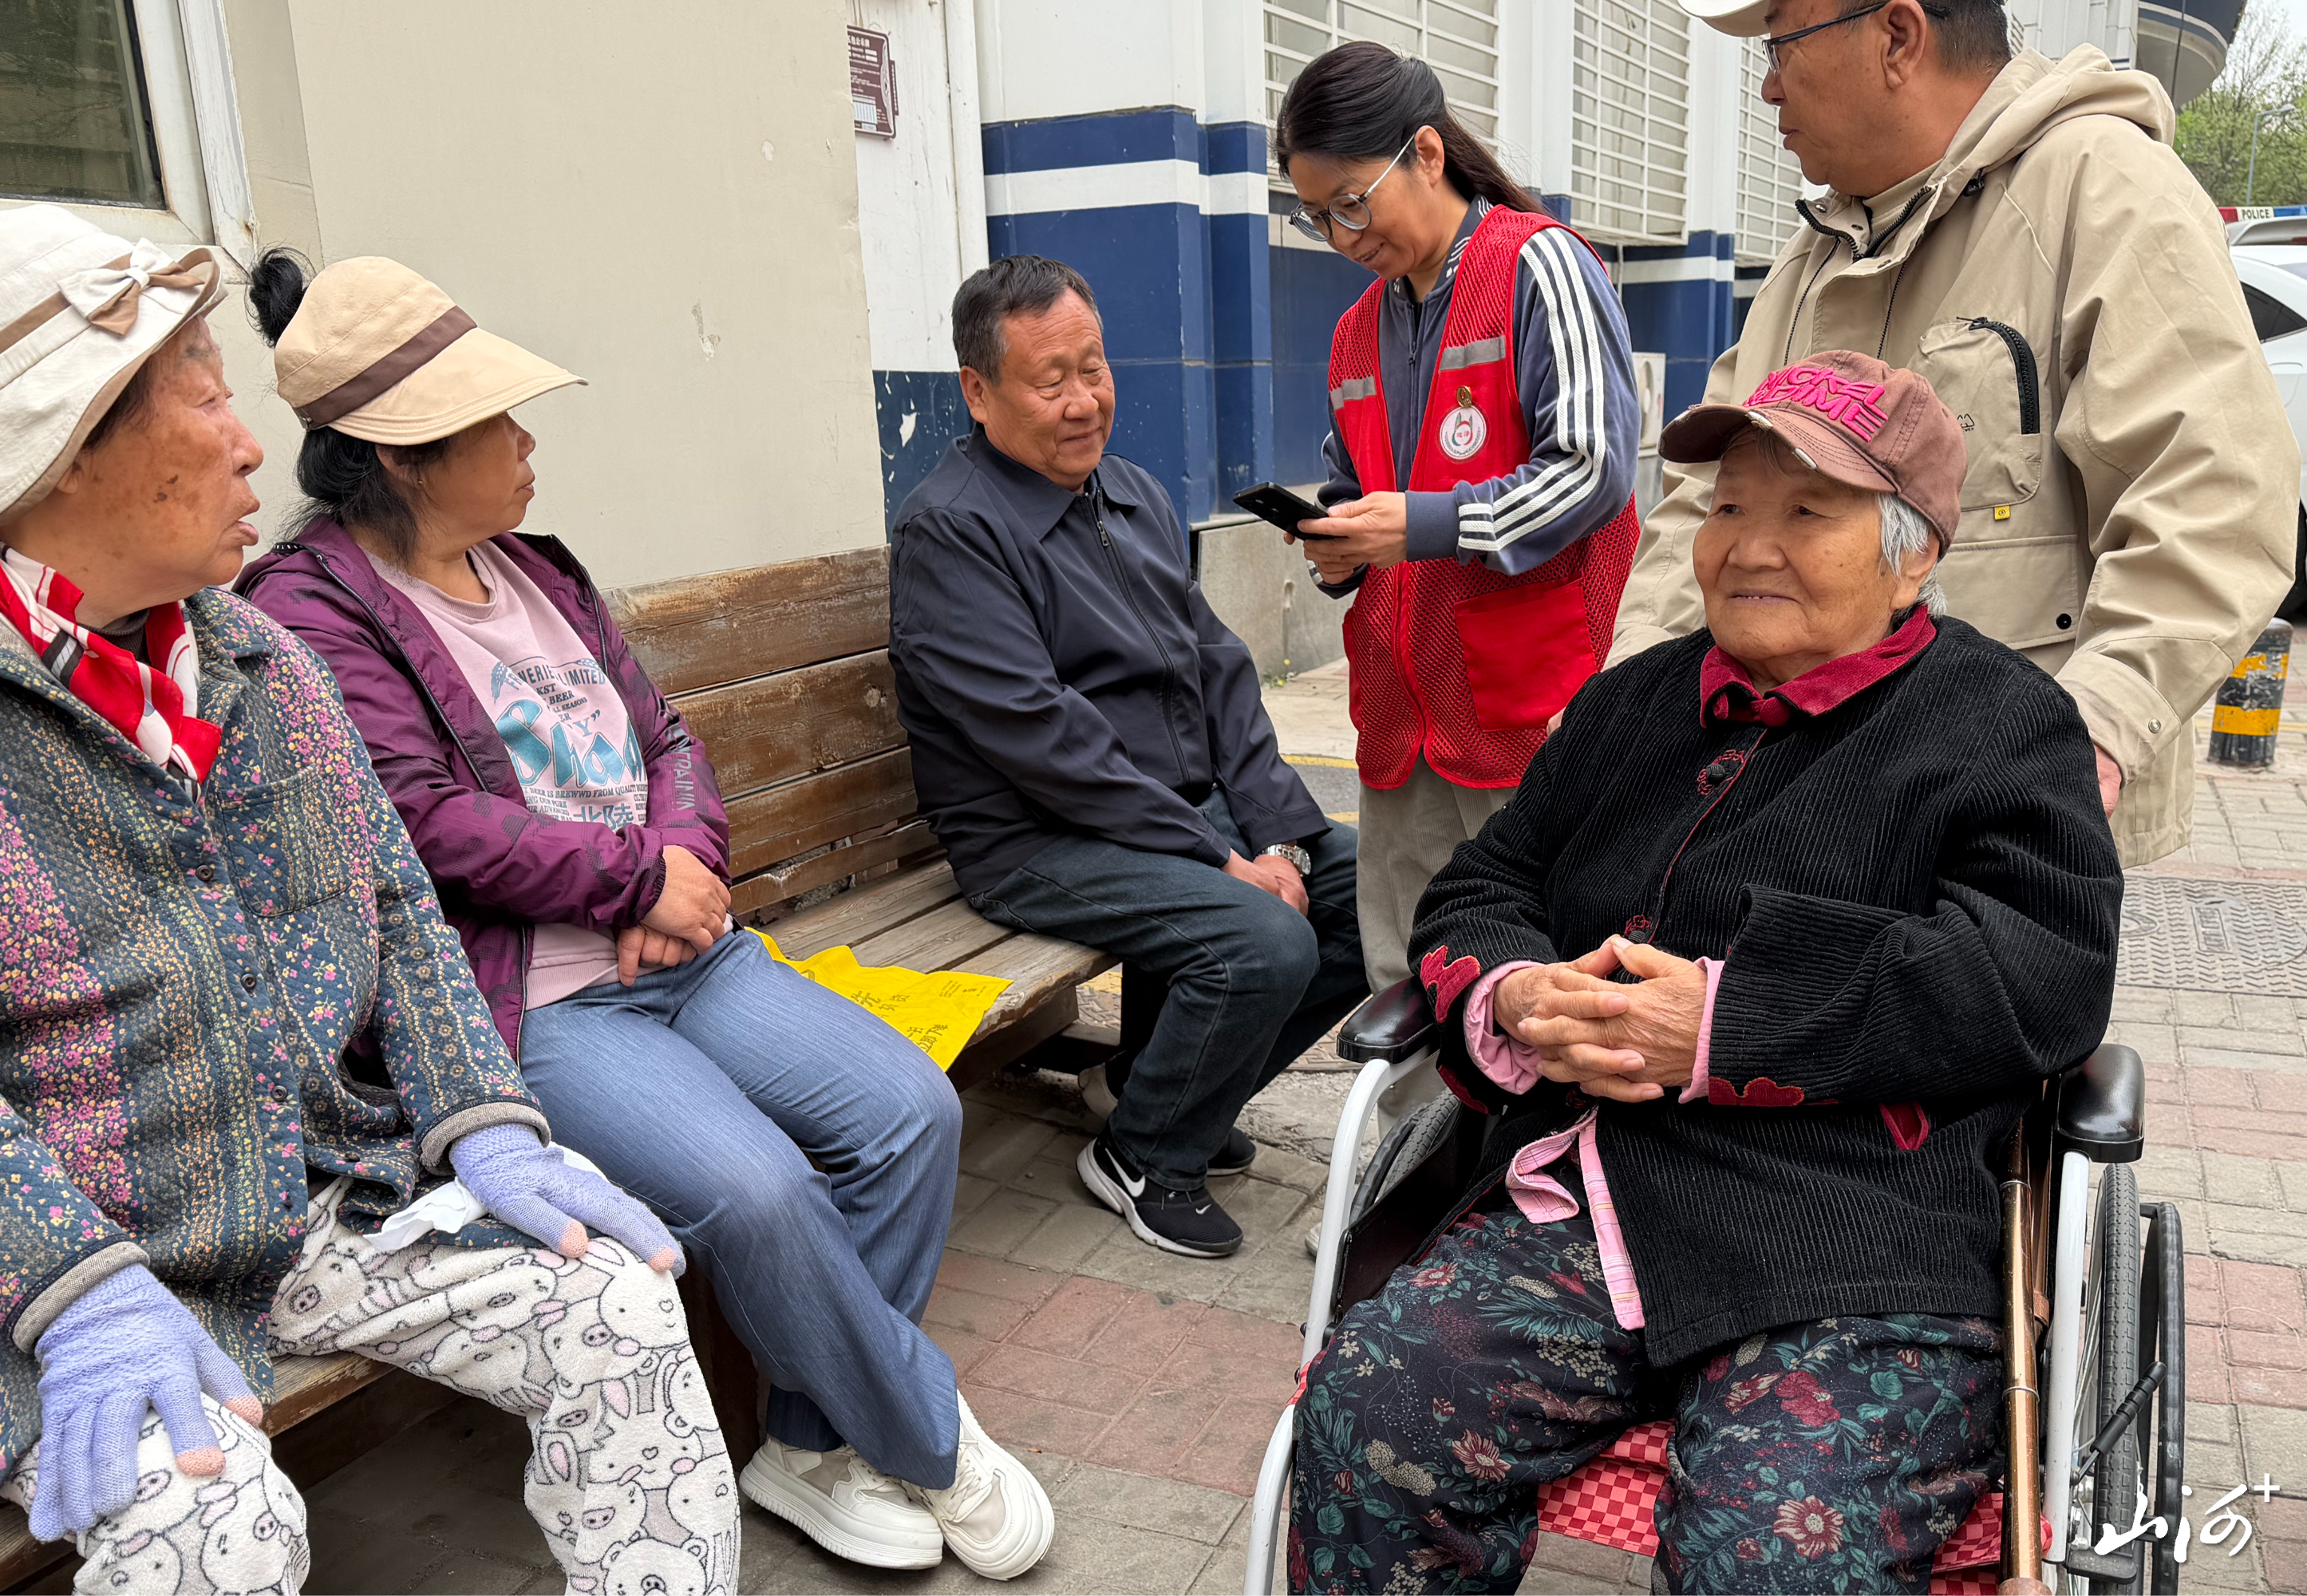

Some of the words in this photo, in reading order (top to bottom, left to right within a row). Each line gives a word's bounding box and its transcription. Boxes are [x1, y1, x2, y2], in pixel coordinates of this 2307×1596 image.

[2241, 208, 2269, 219] POLICE
[1758, 365, 1889, 421] NICKEL
[1762, 383, 1882, 442] DIME
[556, 669, 606, 686] LIMITED
[549, 690, 575, 705] BEER
[555, 790, 592, 799] BREWWD
[592, 787, 614, 798] FROM
